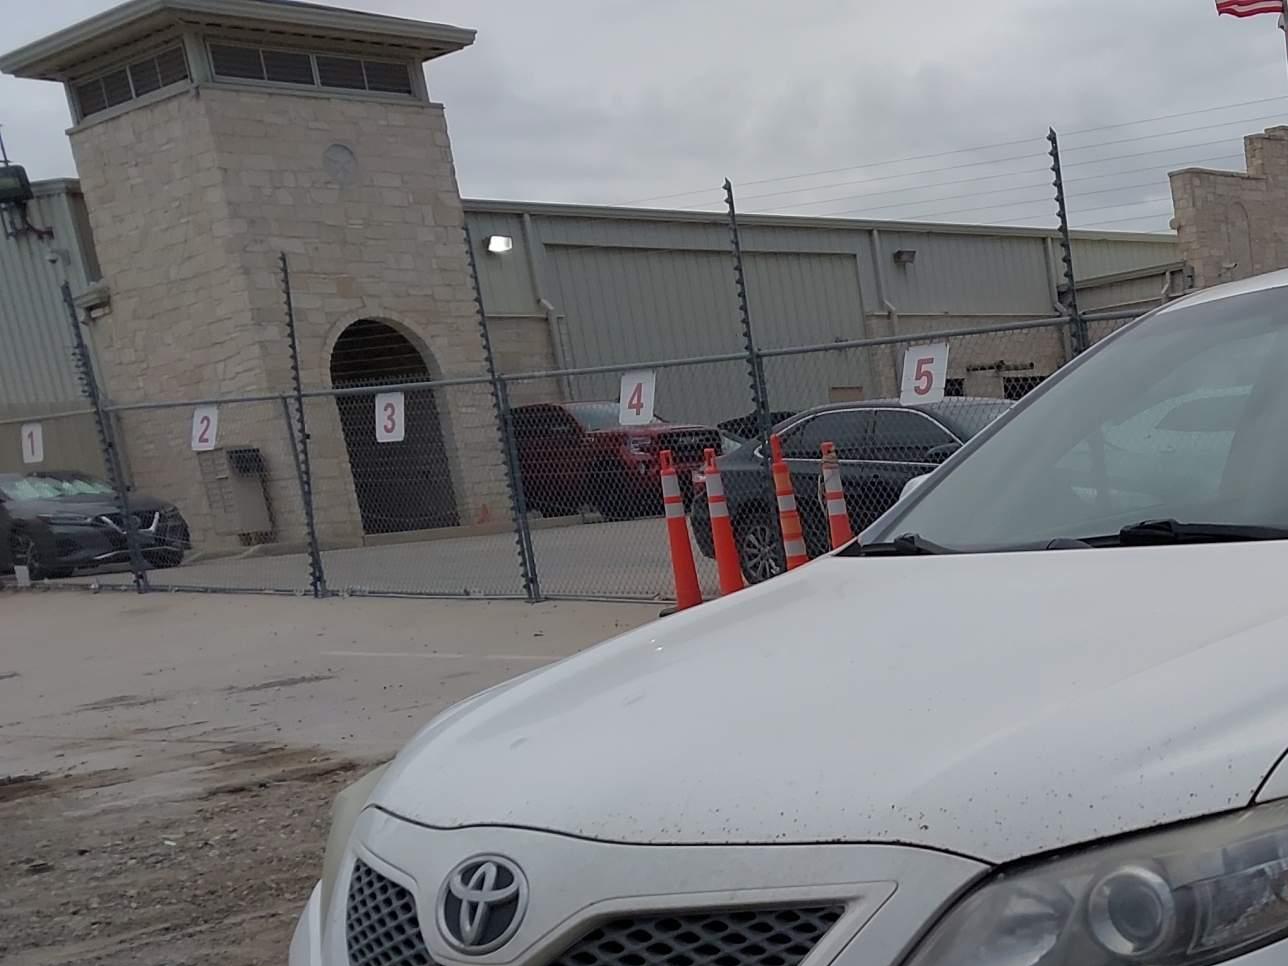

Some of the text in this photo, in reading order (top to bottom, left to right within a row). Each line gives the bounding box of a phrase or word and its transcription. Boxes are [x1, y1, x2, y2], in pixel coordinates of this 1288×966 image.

[913, 357, 934, 396] 5
[627, 382, 645, 416] 4
[198, 415, 211, 443] 2
[383, 402, 397, 434] 3
[27, 430, 36, 456] 1
